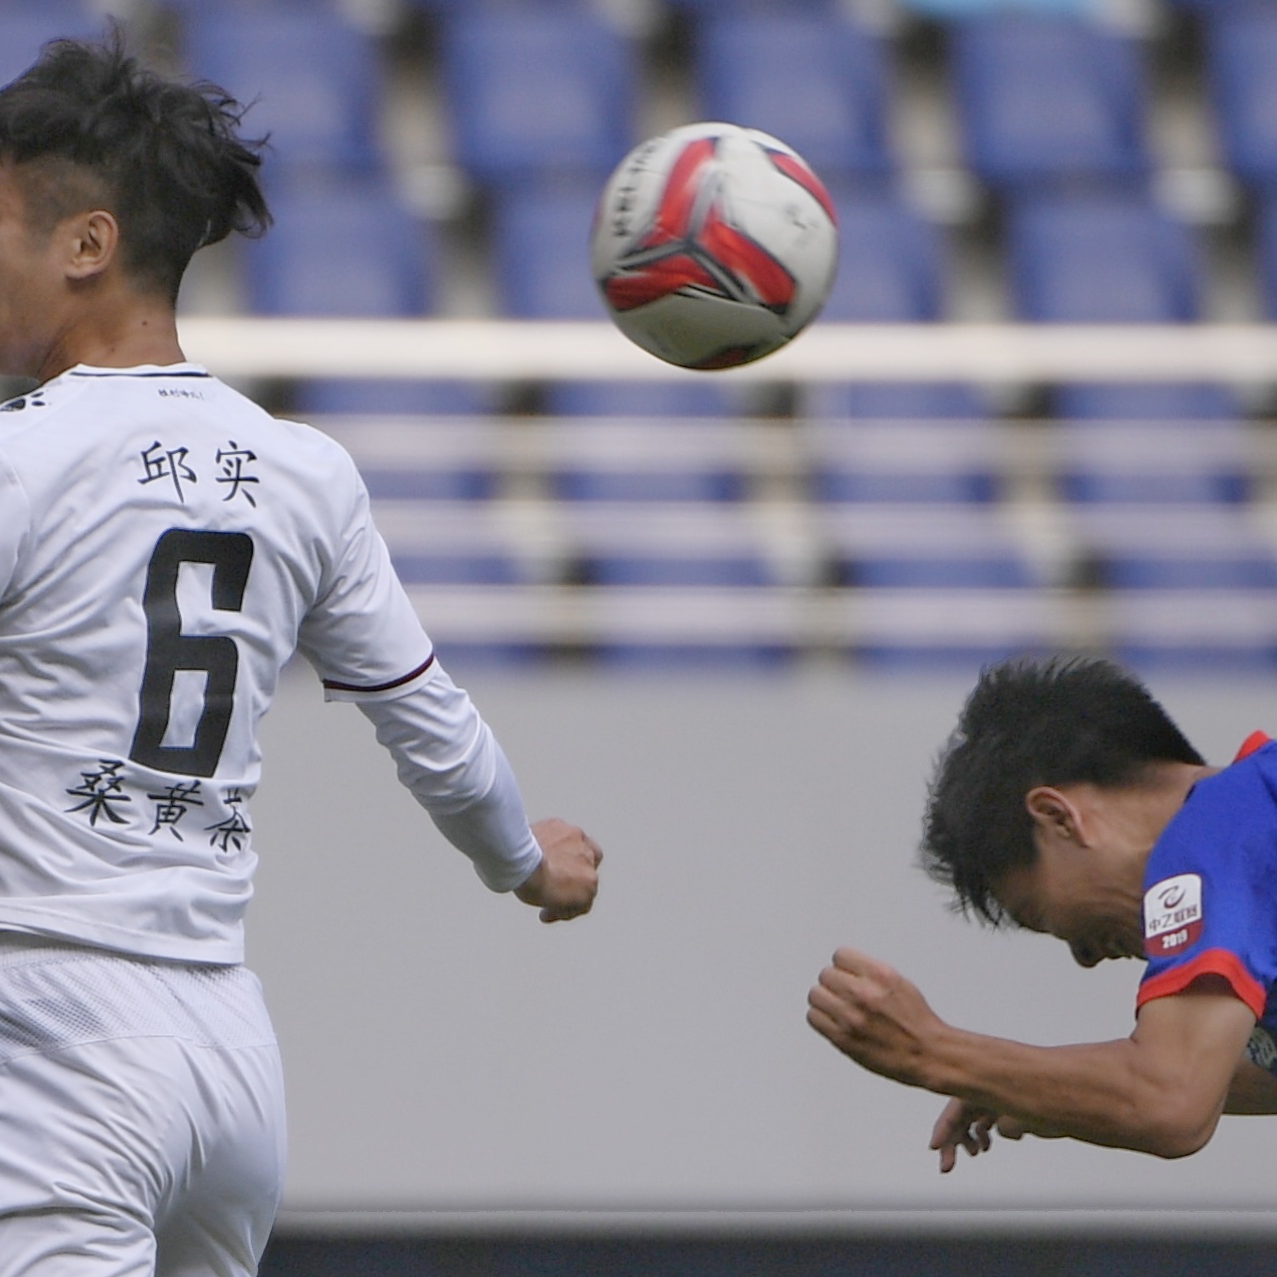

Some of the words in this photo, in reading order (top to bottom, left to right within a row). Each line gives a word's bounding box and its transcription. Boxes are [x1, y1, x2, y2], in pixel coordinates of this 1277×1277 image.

[136, 440, 260, 507] 邱实
[129, 528, 254, 778] 6
[65, 759, 252, 853] 桑黄茶
